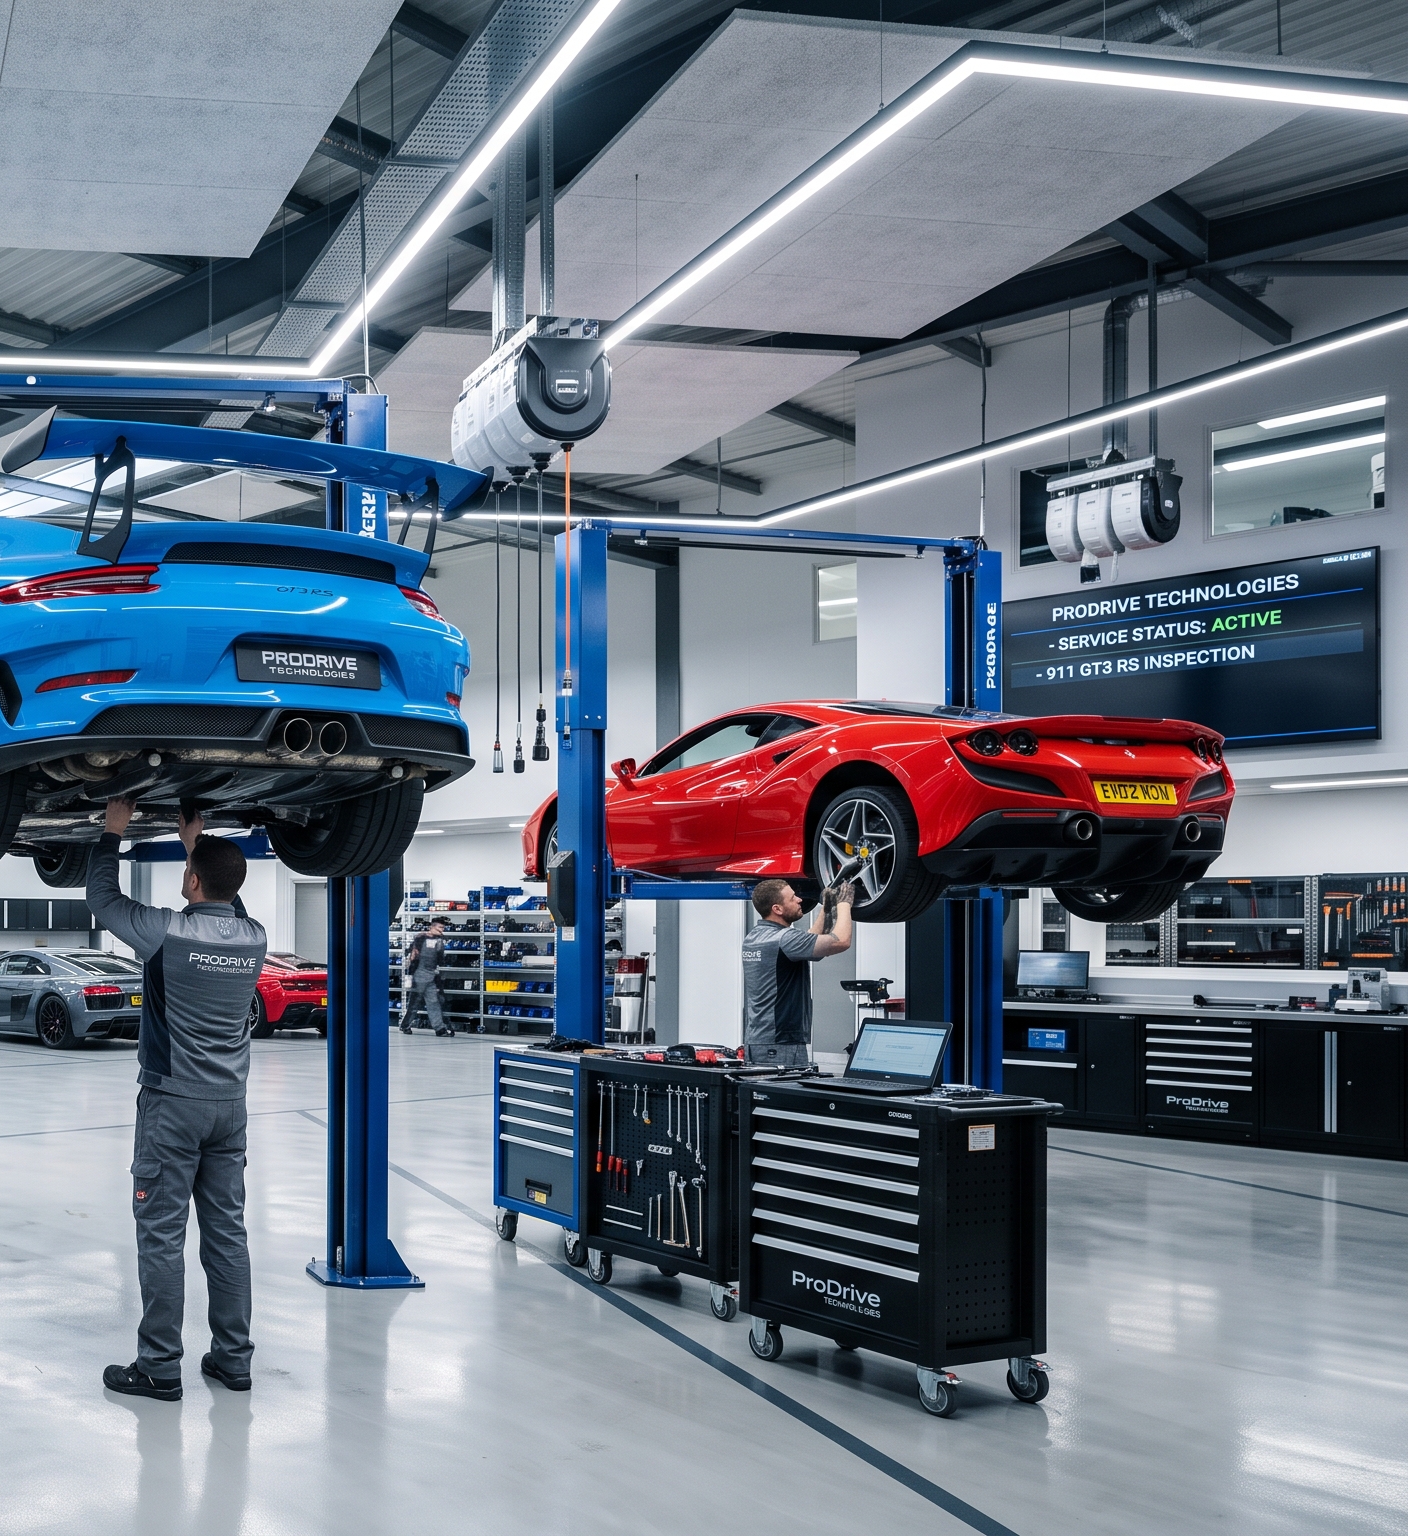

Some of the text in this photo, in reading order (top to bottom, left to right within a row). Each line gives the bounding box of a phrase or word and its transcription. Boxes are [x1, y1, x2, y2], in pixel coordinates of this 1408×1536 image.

[1052, 574, 1299, 622] PRODRIVE TECHNOLOGIES
[1058, 629, 1128, 651] SERVICE
[1132, 620, 1206, 642] STATUS:
[1211, 610, 1282, 633] ACTIVE
[261, 650, 358, 671] PRODRIVE
[1046, 665, 1074, 680] 911
[1079, 660, 1112, 677] GT3
[1117, 657, 1140, 673] RS
[1144, 644, 1255, 671] INSPECTION
[188, 952, 257, 967] PRODRIVE
[1166, 1095, 1229, 1108] ProDrive
[792, 1270, 881, 1308] ProDrive
